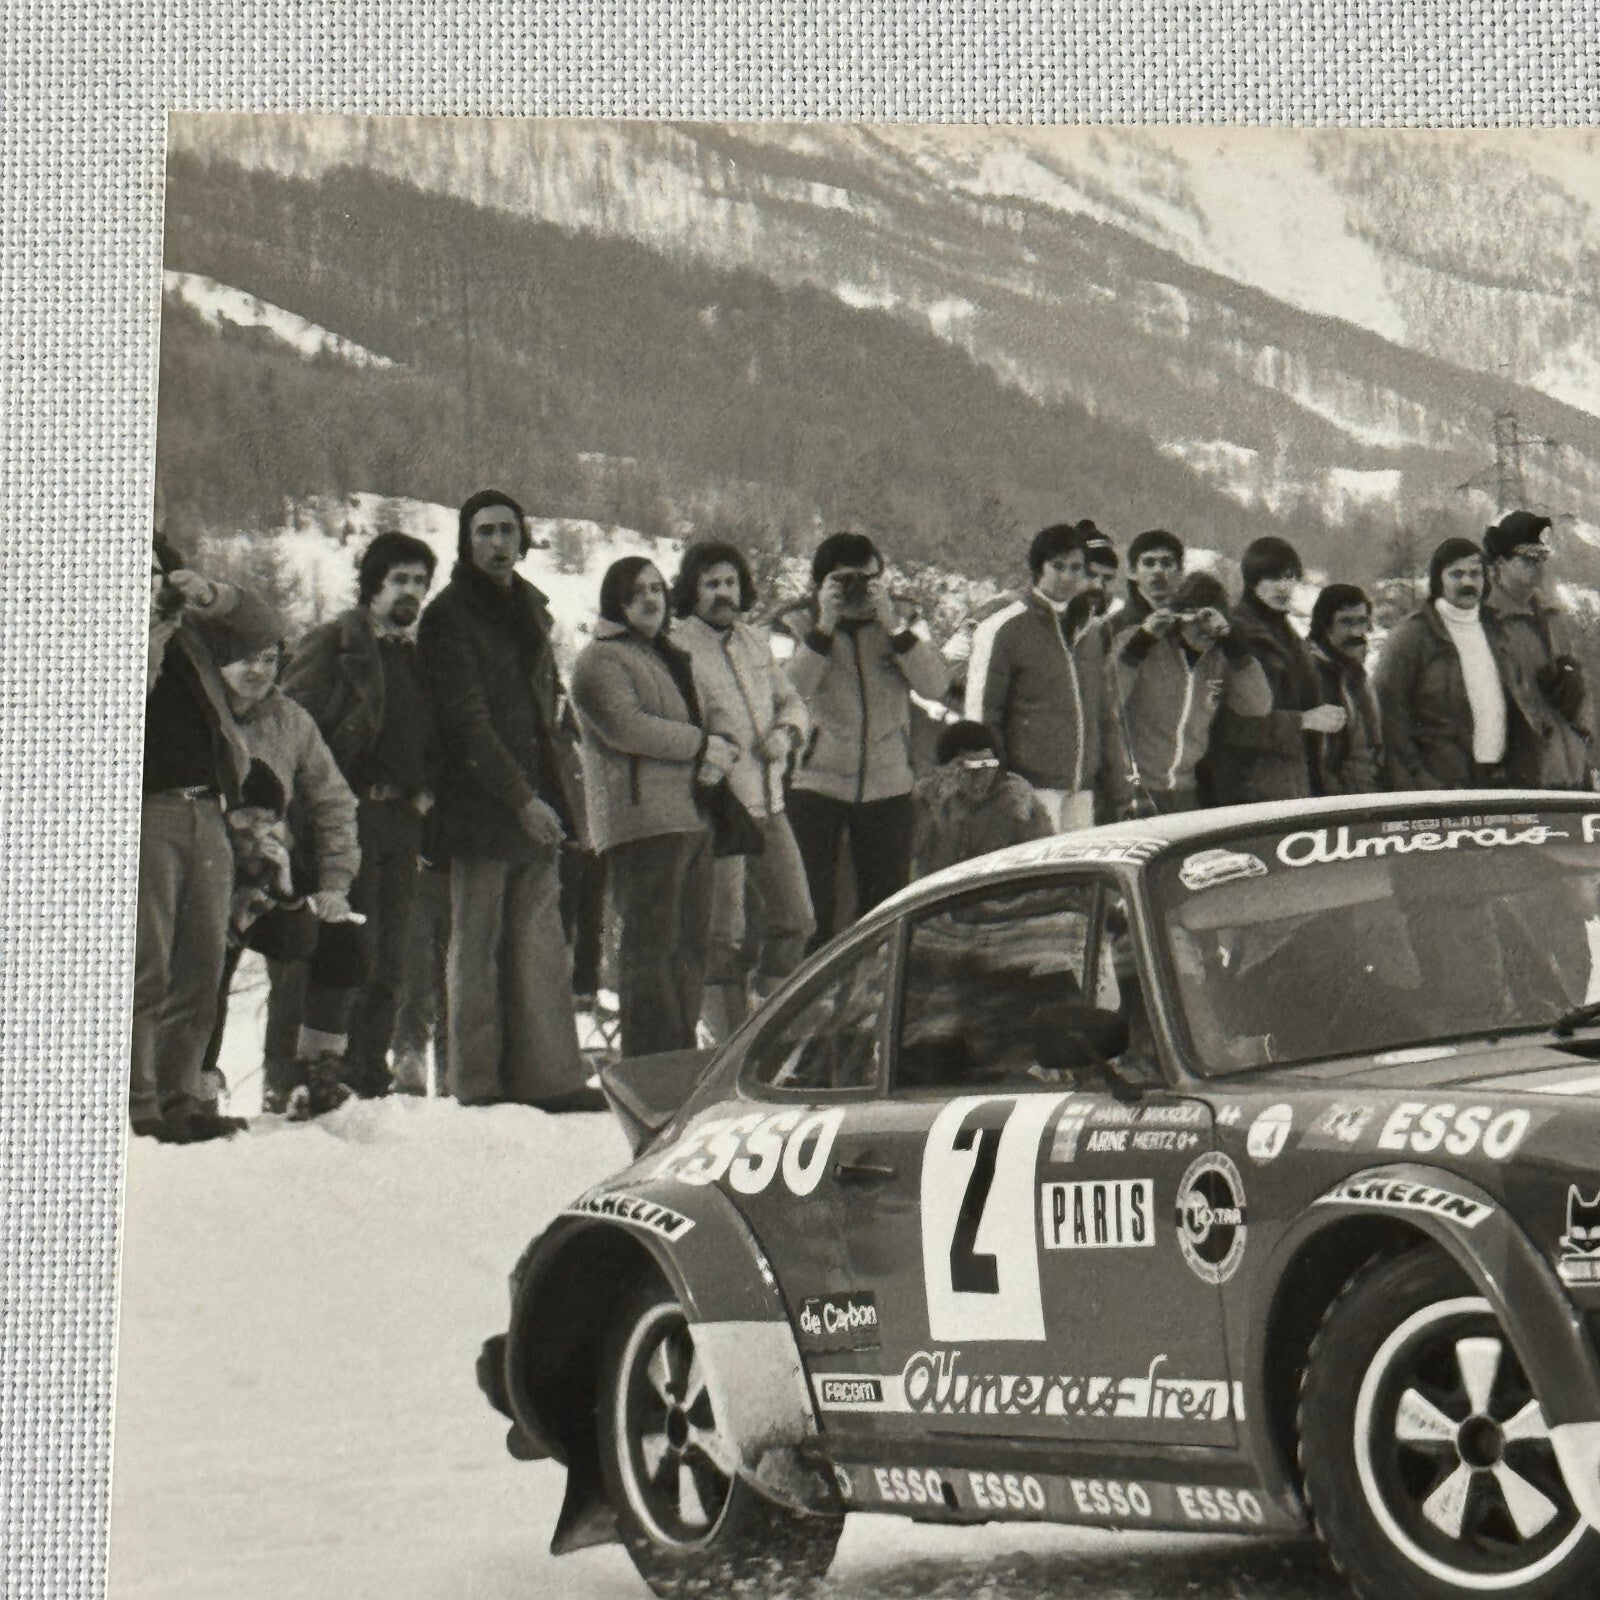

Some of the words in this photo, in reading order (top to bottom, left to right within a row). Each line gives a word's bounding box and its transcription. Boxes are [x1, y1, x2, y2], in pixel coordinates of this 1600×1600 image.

[1086, 1130, 1130, 1151] ARNE
[1377, 1102, 1530, 1160] ESSO
[648, 1107, 846, 1197] ESSO
[950, 1099, 1018, 1294] 2
[1052, 1183, 1146, 1245] PARIS
[1332, 1181, 1477, 1218] ICHELIN
[800, 1305, 821, 1335] de
[823, 1300, 878, 1334] Carbon
[874, 1467, 947, 1505] ESSO
[968, 1471, 1047, 1511] ESSO
[1070, 1479, 1152, 1517] ESSO
[1176, 1485, 1265, 1524] ESSO
